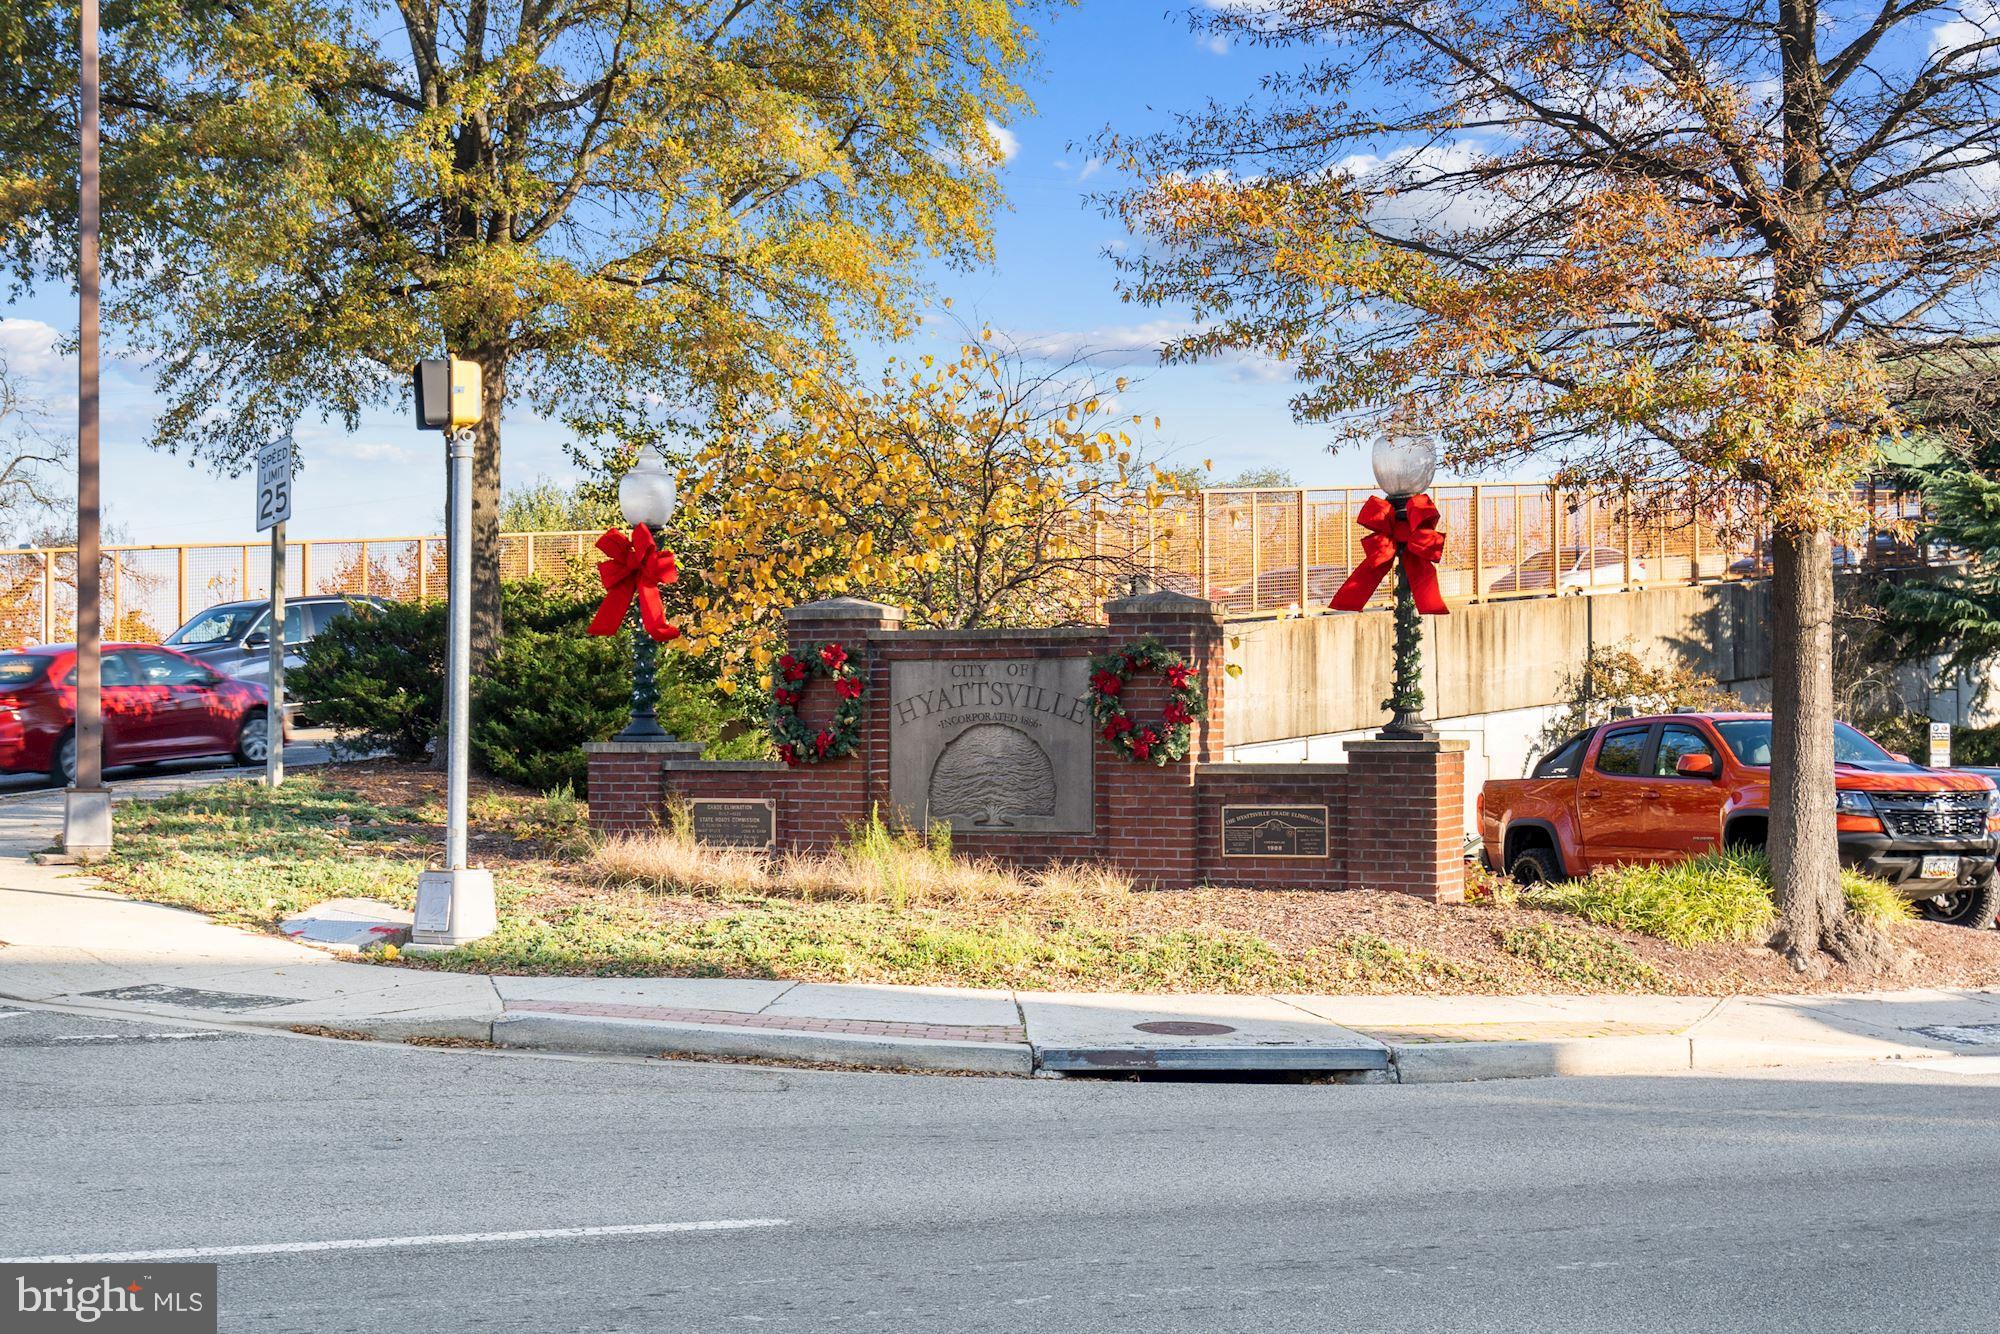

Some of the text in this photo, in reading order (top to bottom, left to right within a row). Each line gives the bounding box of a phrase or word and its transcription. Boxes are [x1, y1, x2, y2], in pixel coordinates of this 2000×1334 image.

[261, 447, 288, 469] SPEED
[263, 465, 285, 485] LIMIT
[260, 481, 287, 520] 25
[951, 664, 1029, 678] CITY OF
[893, 681, 1090, 726] HYATTSVILLE
[940, 712, 1018, 729] INCORPORATED
[1236, 811, 1270, 822] HYATTSVILLE
